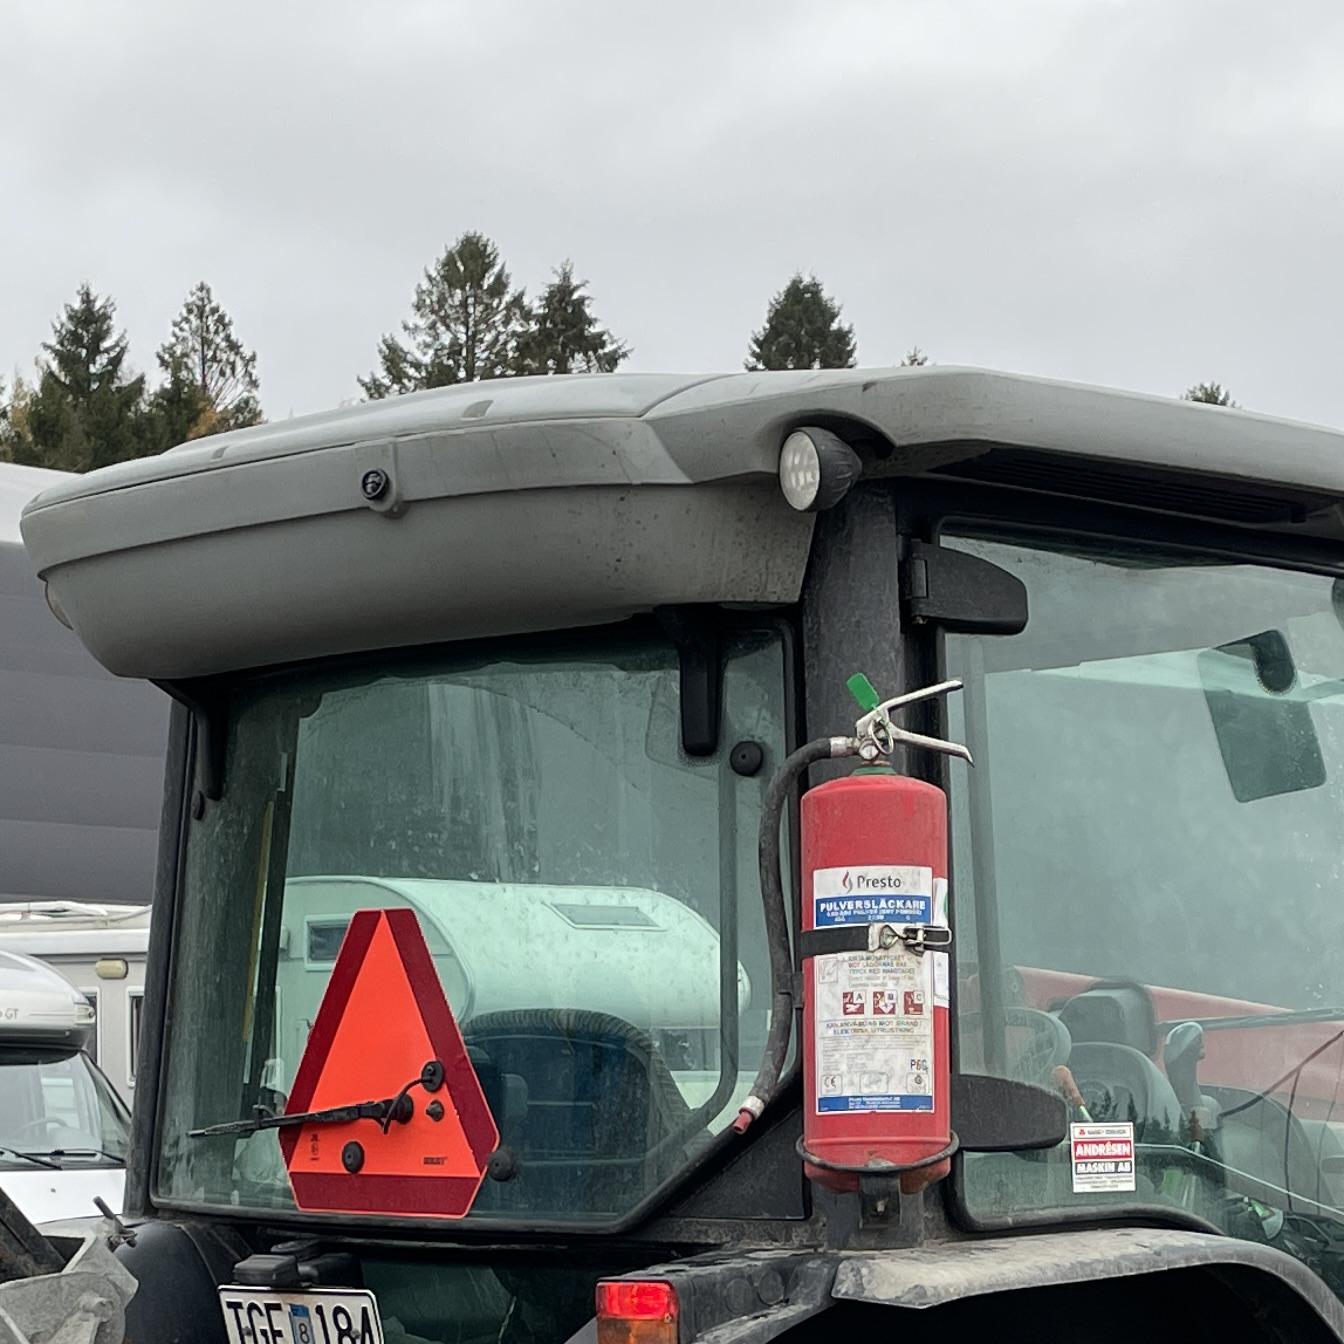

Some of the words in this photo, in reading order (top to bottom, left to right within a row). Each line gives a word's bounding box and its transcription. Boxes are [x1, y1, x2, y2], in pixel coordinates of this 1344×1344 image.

[857, 875, 902, 889] Presto
[4, 1008, 19, 1020] GT
[1076, 1162, 1115, 1173] MASKIN
[1117, 1161, 1131, 1172] AB
[298, 1321, 310, 1344] 8
